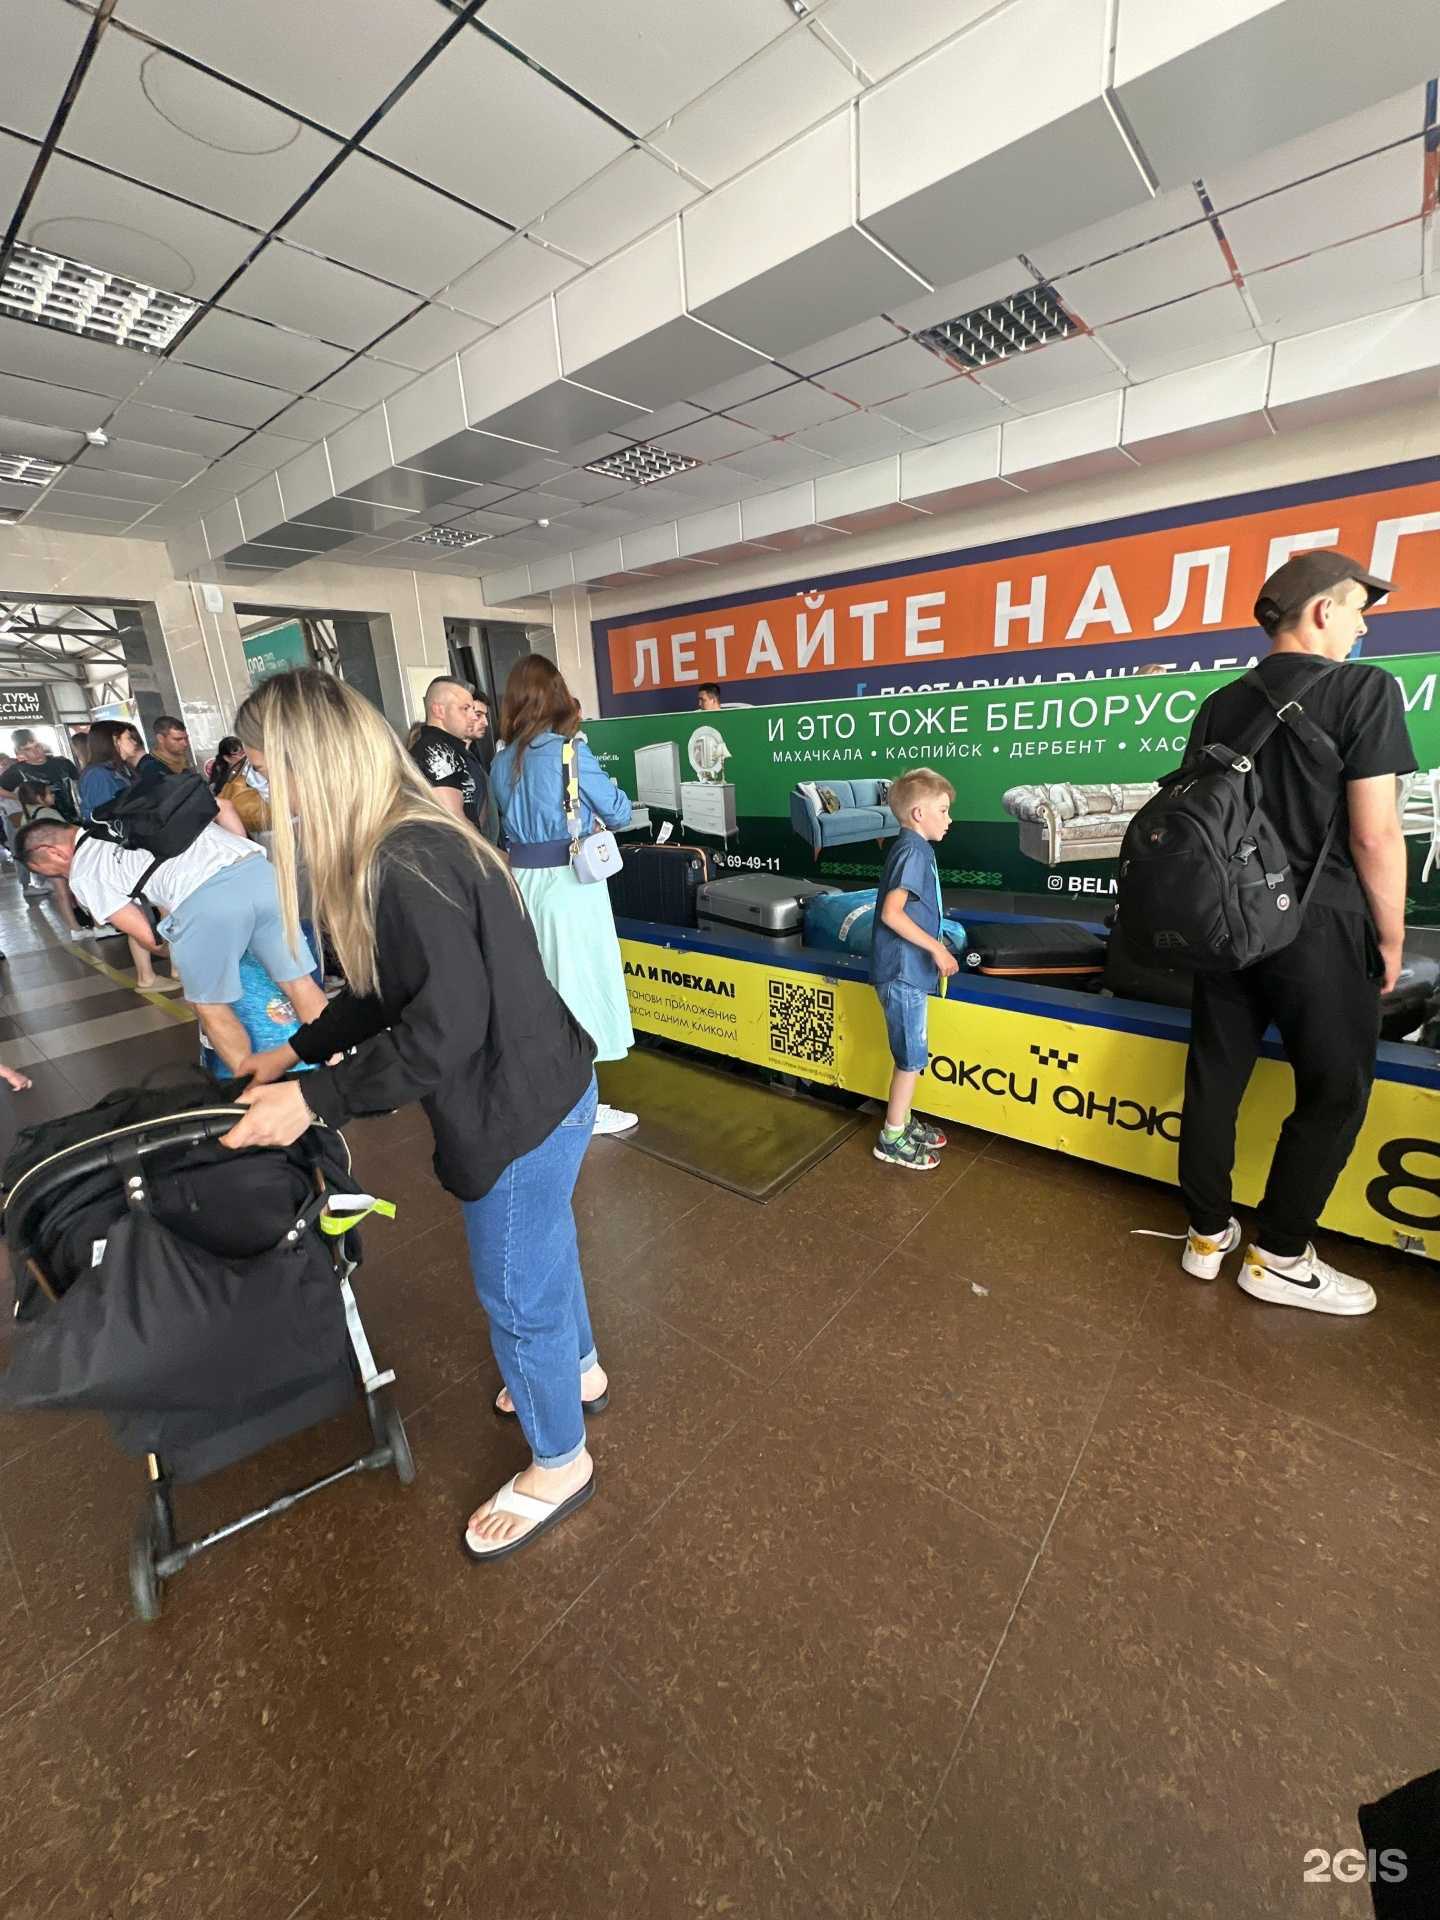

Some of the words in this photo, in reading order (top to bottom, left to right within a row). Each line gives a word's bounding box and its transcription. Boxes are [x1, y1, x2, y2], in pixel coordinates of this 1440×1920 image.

[633, 591, 946, 688] ЛЕТАЙТЕ
[2, 692, 39, 702] ТУРЫ
[768, 718, 785, 742] И
[797, 713, 857, 742] ЭТО
[868, 706, 970, 738] ТОЖЕ
[986, 690, 1216, 733] БЕЛОРУС
[772, 748, 863, 763] МАХАЧКАЛА
[886, 742, 983, 760] КАСПИЙСК
[1010, 740, 1107, 758] ДЕРБЕНТ
[727, 855, 780, 871] 69-49-11
[649, 967, 658, 980] И
[661, 968, 735, 998] ПОЕХАЛ!
[665, 997, 738, 1024] приложение
[653, 1010, 689, 1029] одним
[692, 1021, 738, 1042] кликом!
